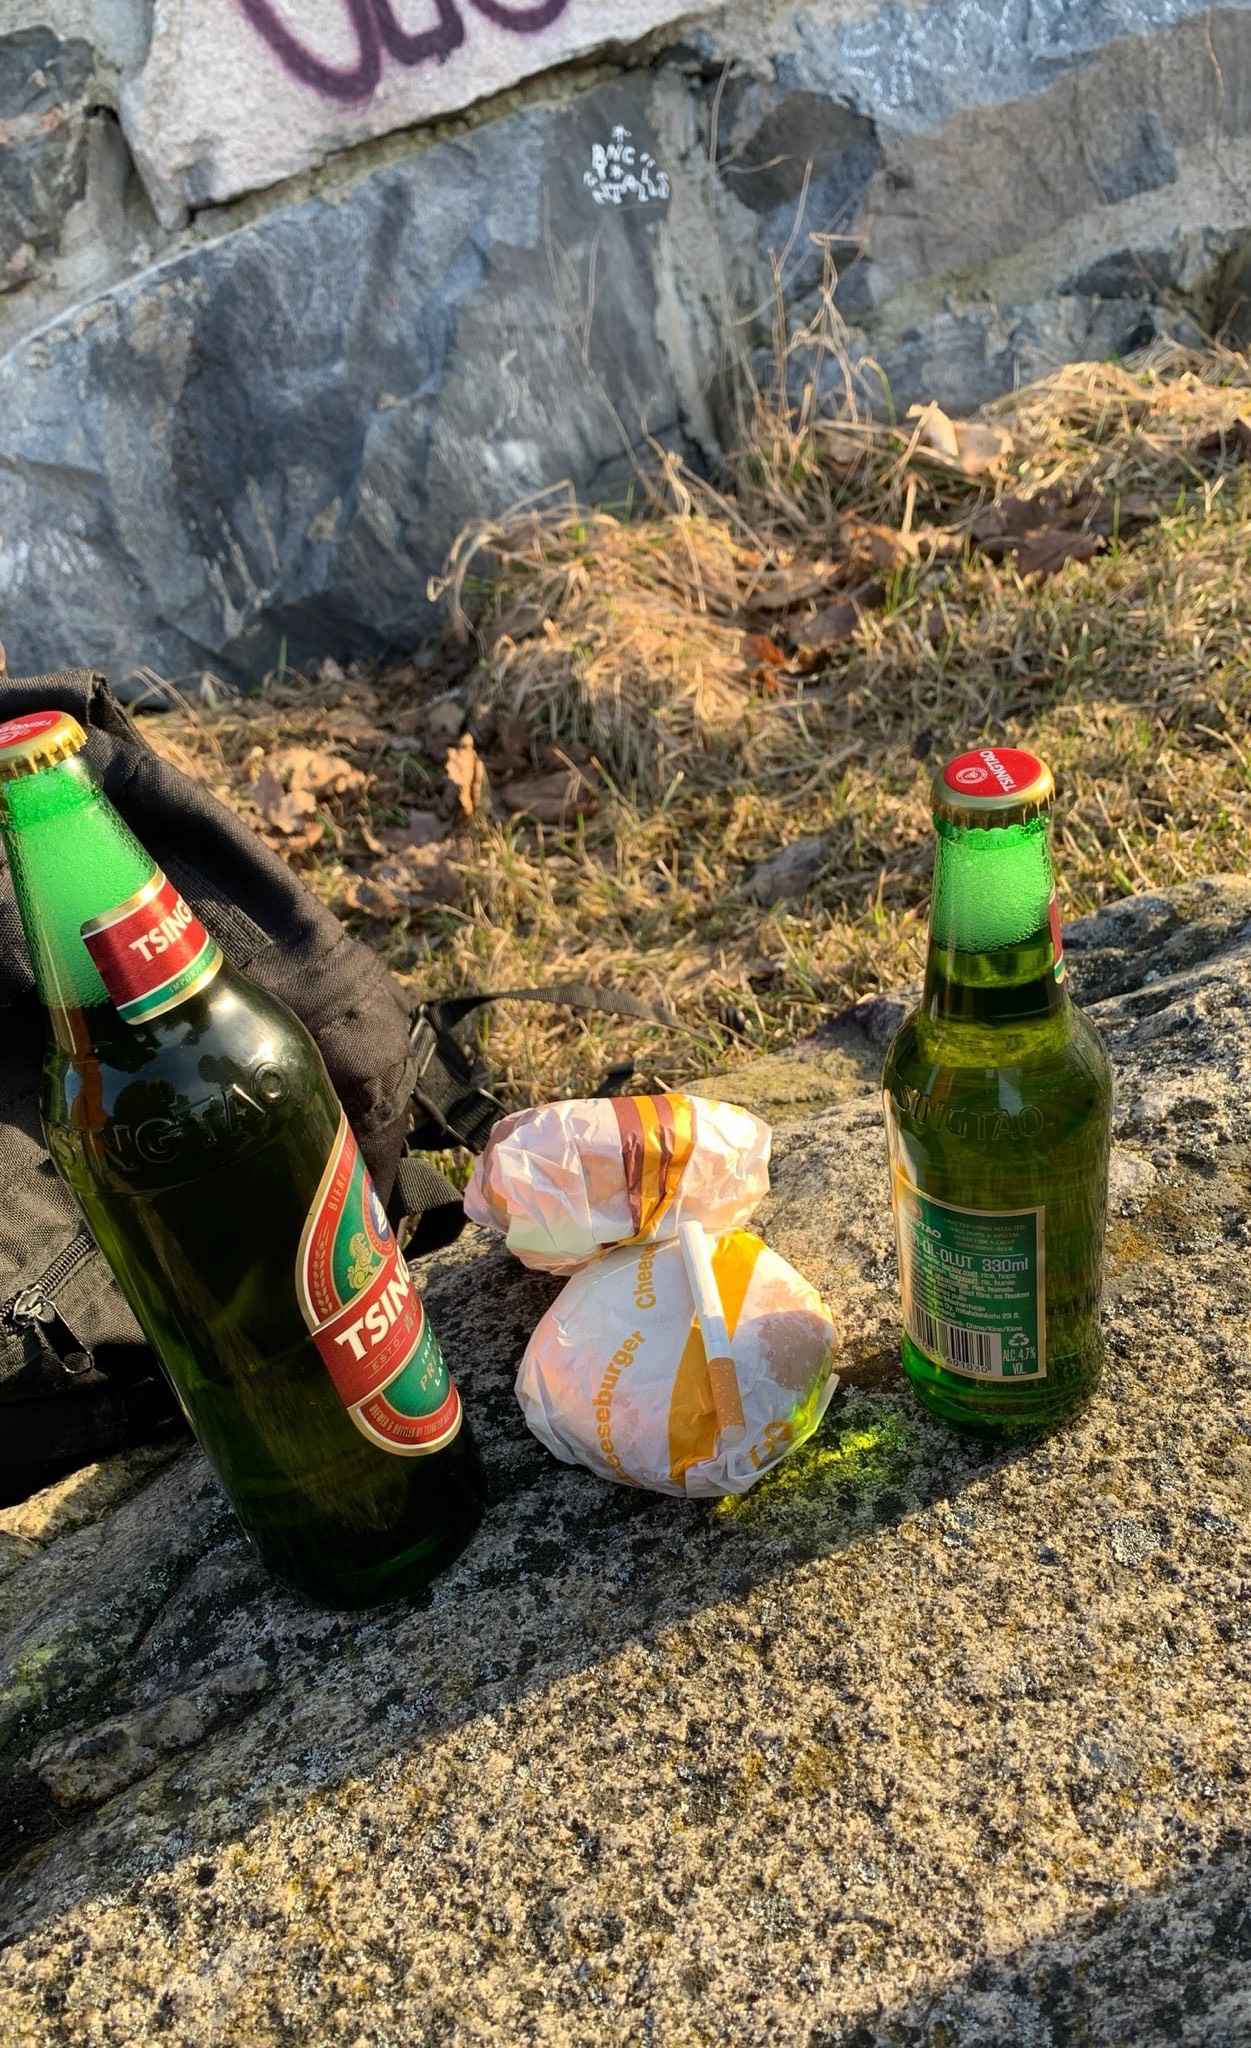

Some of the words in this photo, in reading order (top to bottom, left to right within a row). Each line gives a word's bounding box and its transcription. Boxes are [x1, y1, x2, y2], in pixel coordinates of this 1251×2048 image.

[979, 750, 1018, 792] TSINGTAO
[895, 1078, 1044, 1141] SINGTAO
[982, 1257, 1029, 1272] 330ml
[947, 1358, 988, 1374] 601030
